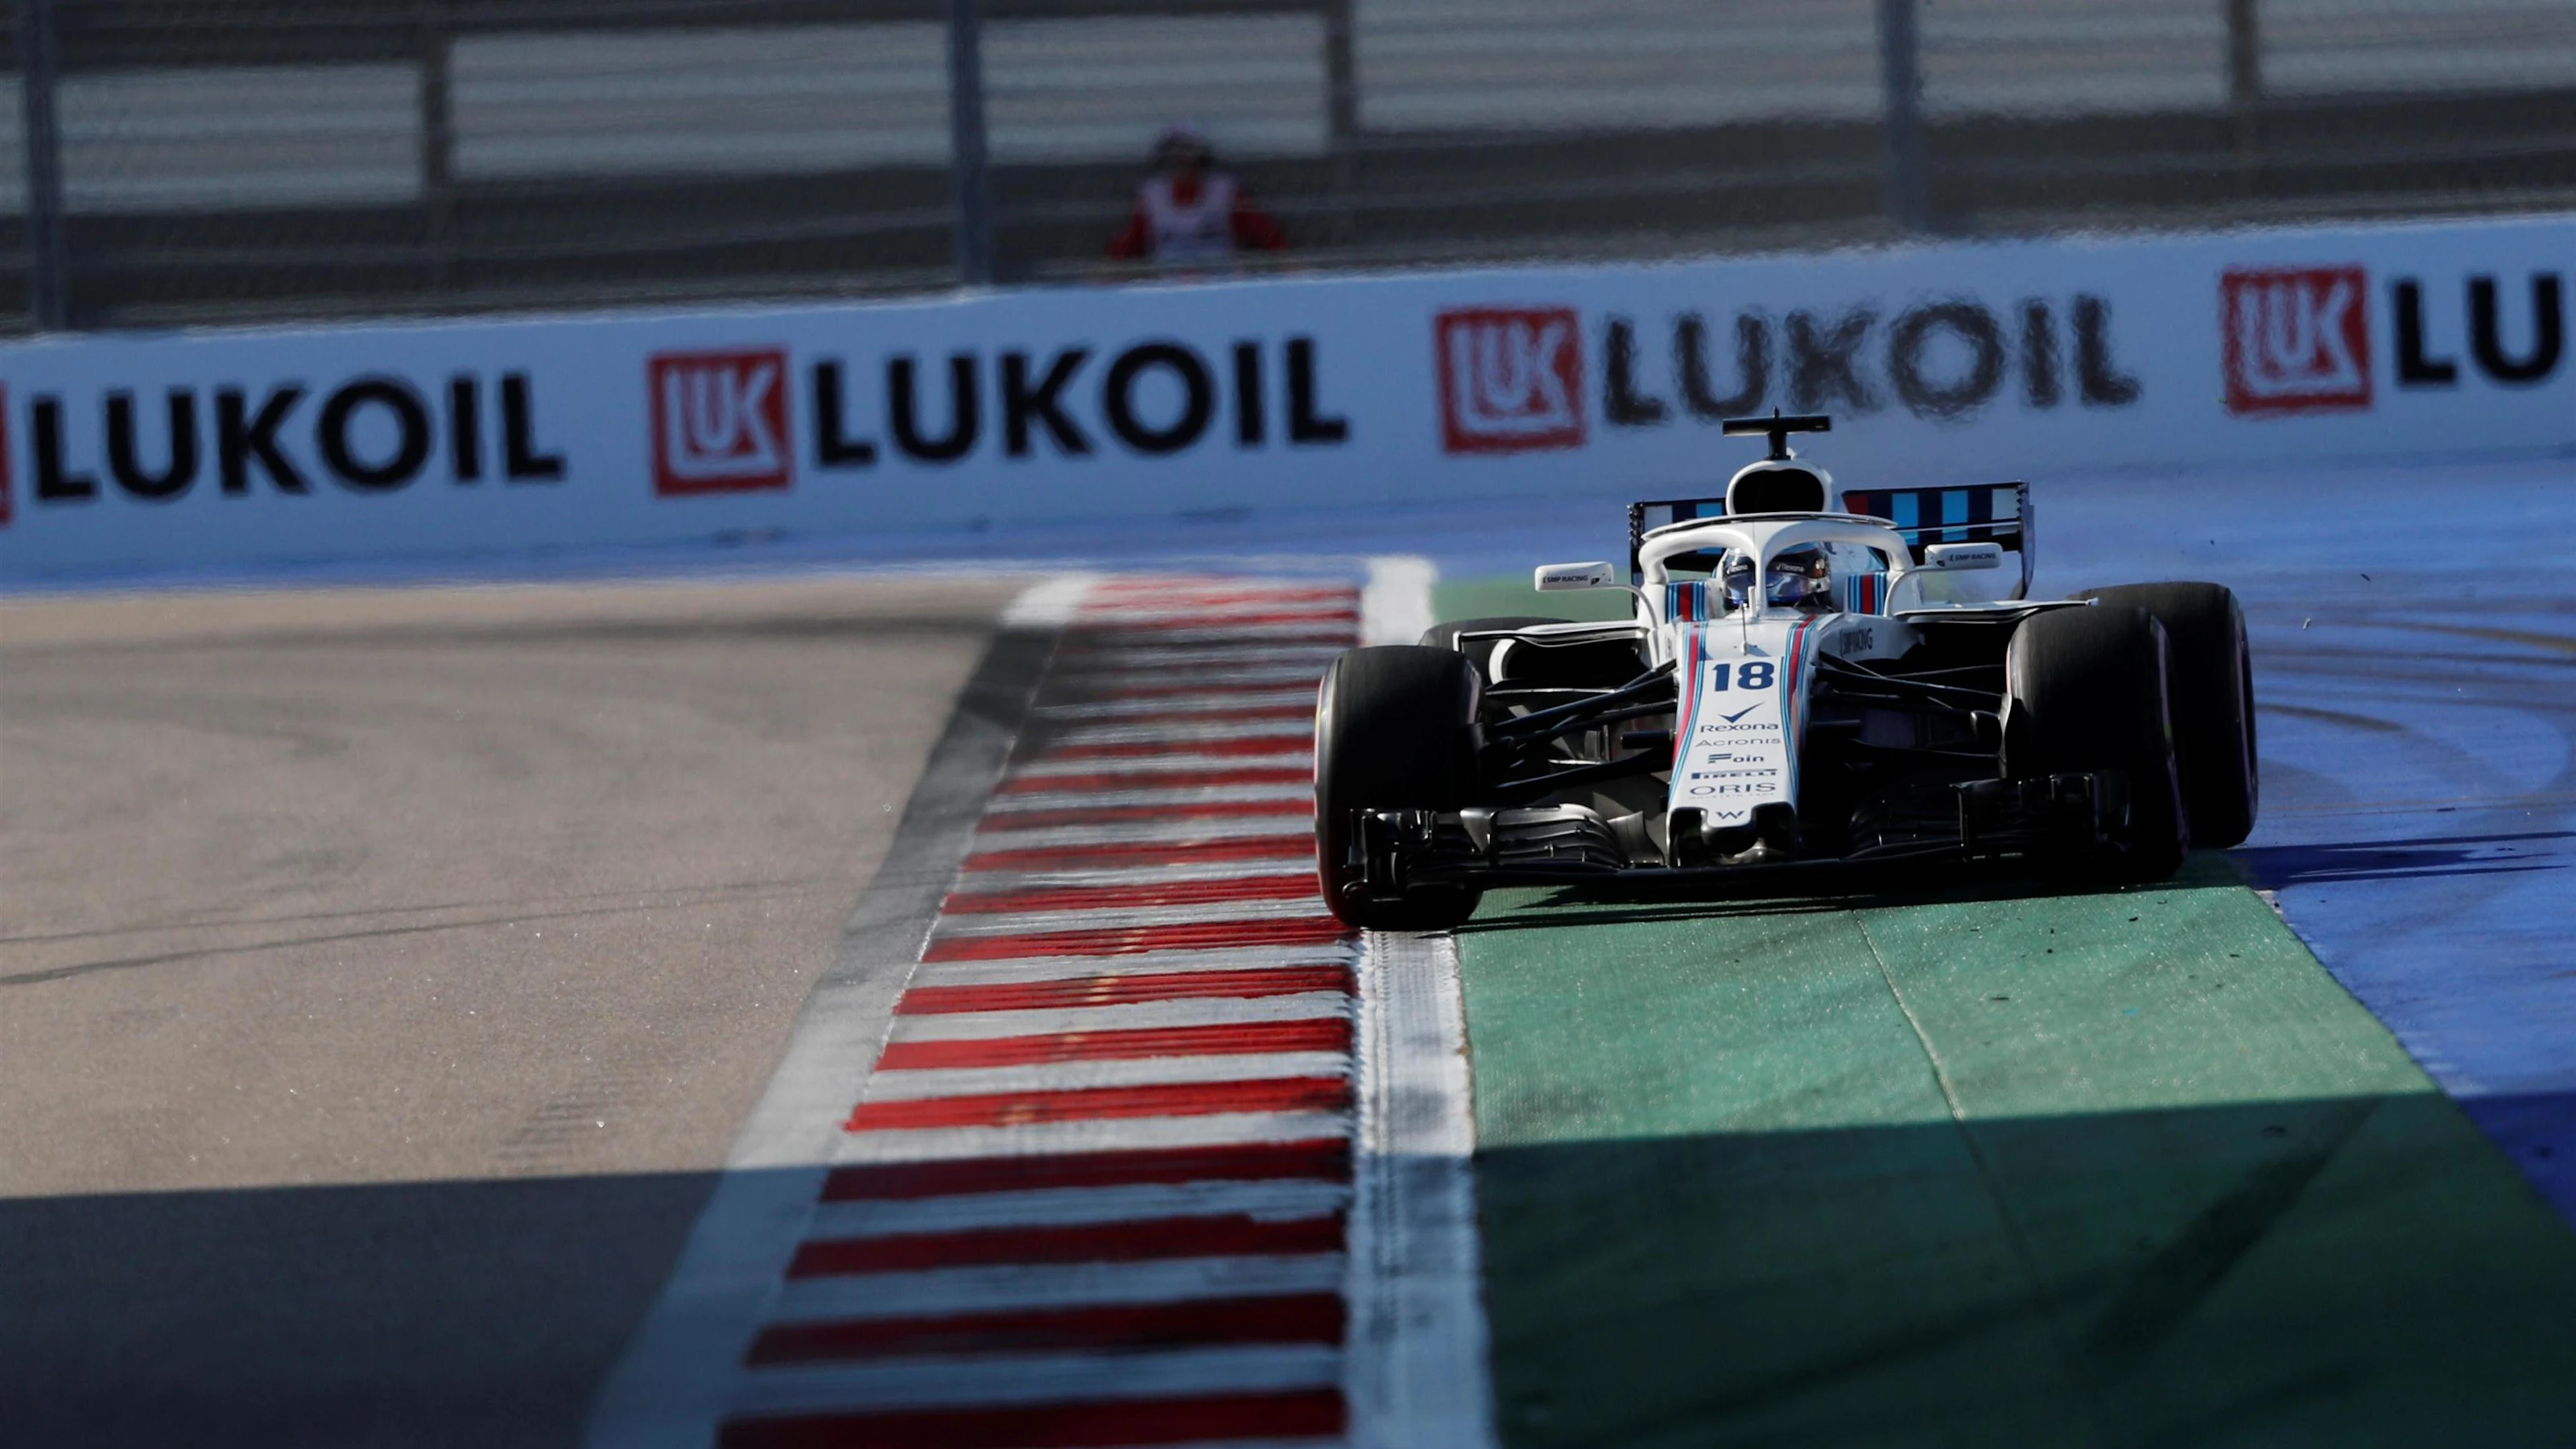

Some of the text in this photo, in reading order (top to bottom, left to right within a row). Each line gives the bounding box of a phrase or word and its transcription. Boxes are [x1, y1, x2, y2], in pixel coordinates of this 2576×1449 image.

[2392, 273, 2563, 386] LU
[1603, 293, 2141, 425] LUKOIL
[811, 337, 1350, 467] LUKOIL
[31, 372, 567, 502] LUKOIL
[1712, 662, 1775, 691] 18
[1700, 723, 1779, 733] Rexona
[1695, 738, 1781, 748] Acronis
[1707, 753, 1765, 764] Foin
[1690, 782, 1777, 795] ORIS
